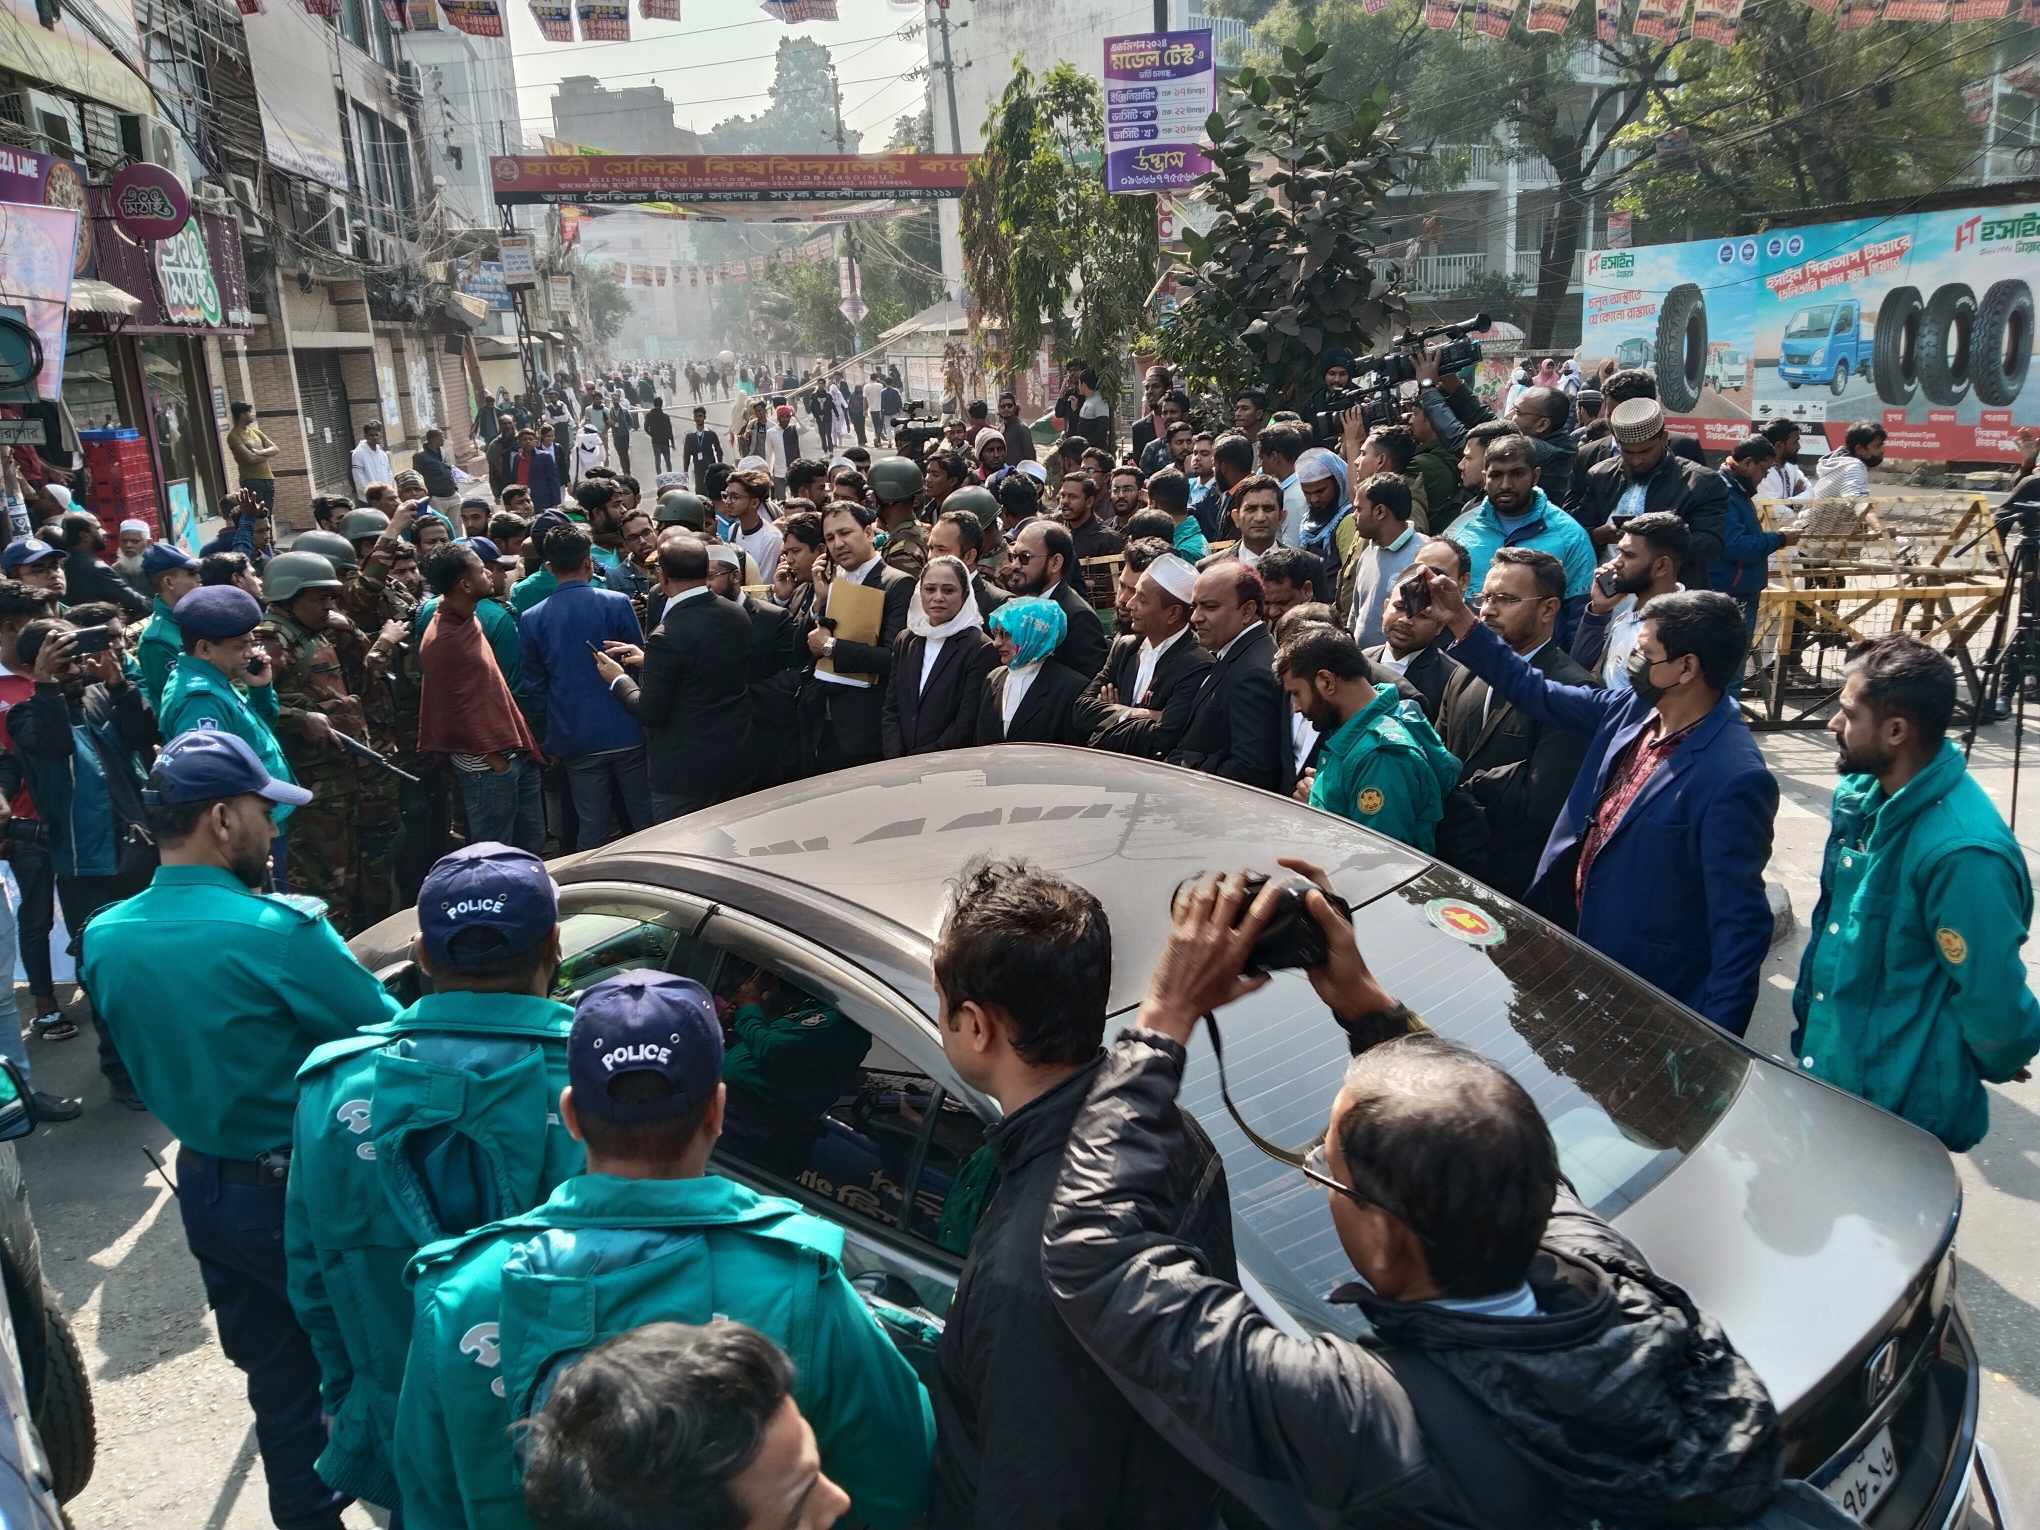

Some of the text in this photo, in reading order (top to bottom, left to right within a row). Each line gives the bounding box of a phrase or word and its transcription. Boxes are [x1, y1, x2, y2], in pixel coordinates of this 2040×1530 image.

[1146, 39, 1167, 49] ২০২৪
[1110, 51, 1161, 70] মডেল
[16, 154, 39, 178] LINE
[524, 156, 593, 177] হাজী
[604, 158, 688, 175] সেলিম
[704, 156, 905, 175] বিশ্ববিদ্যালয়
[1131, 147, 1187, 173] উদ্ভাস
[584, 190, 648, 201] সৈনিক
[1806, 250, 1860, 278] পিকআপ
[1864, 234, 1912, 261] টায়ারে
[446, 897, 504, 920] POLICE
[602, 1044, 672, 1071] POLICE
